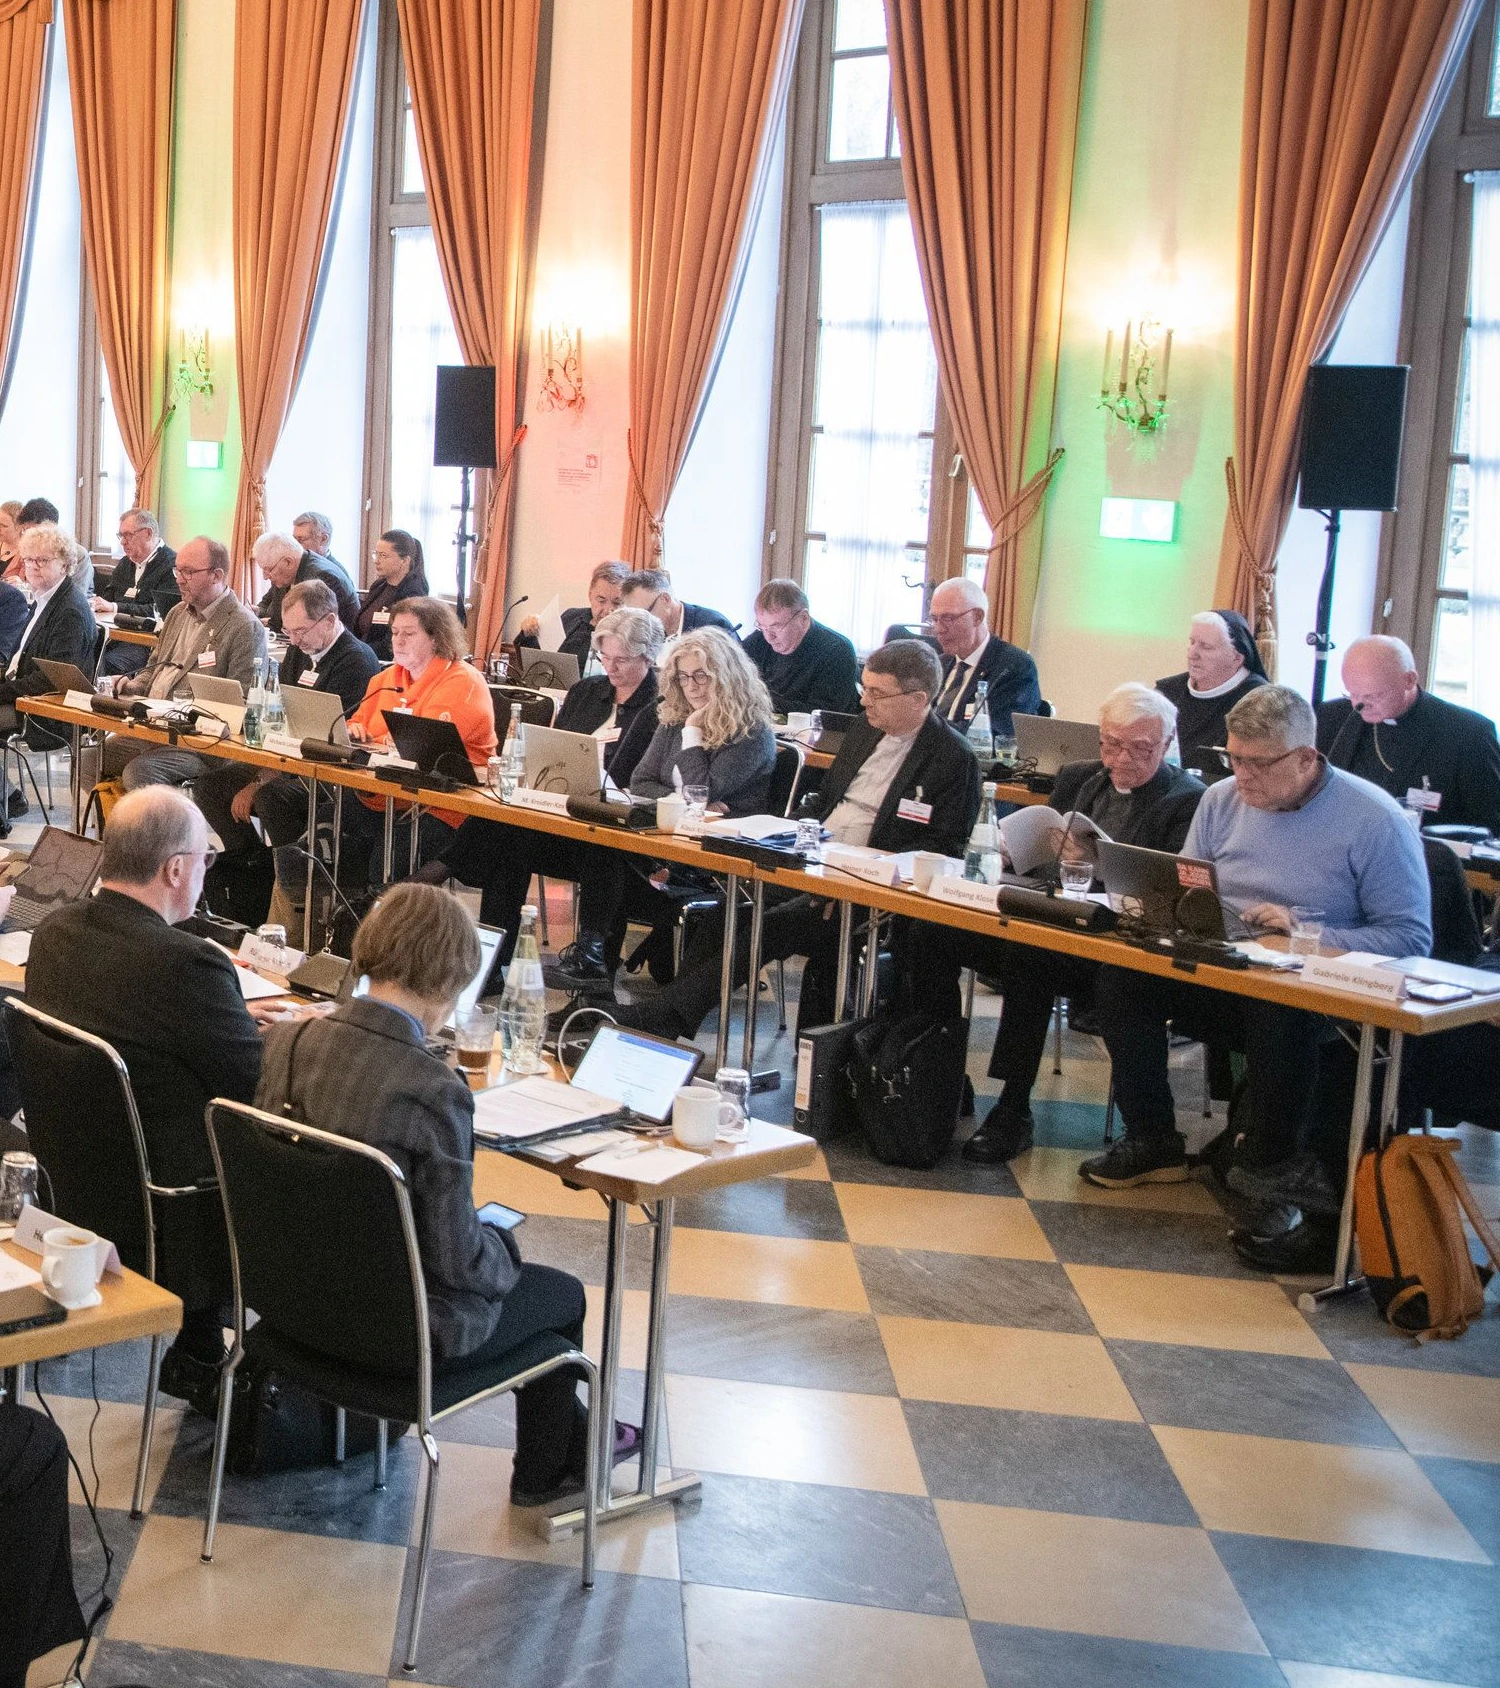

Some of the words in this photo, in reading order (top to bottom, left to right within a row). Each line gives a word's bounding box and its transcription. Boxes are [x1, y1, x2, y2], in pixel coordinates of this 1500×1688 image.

[942, 886, 975, 901] Wolfgang
[975, 893, 995, 904] Klose
[1312, 966, 1351, 983] Gabriele
[1351, 975, 1395, 994] Klingberg
